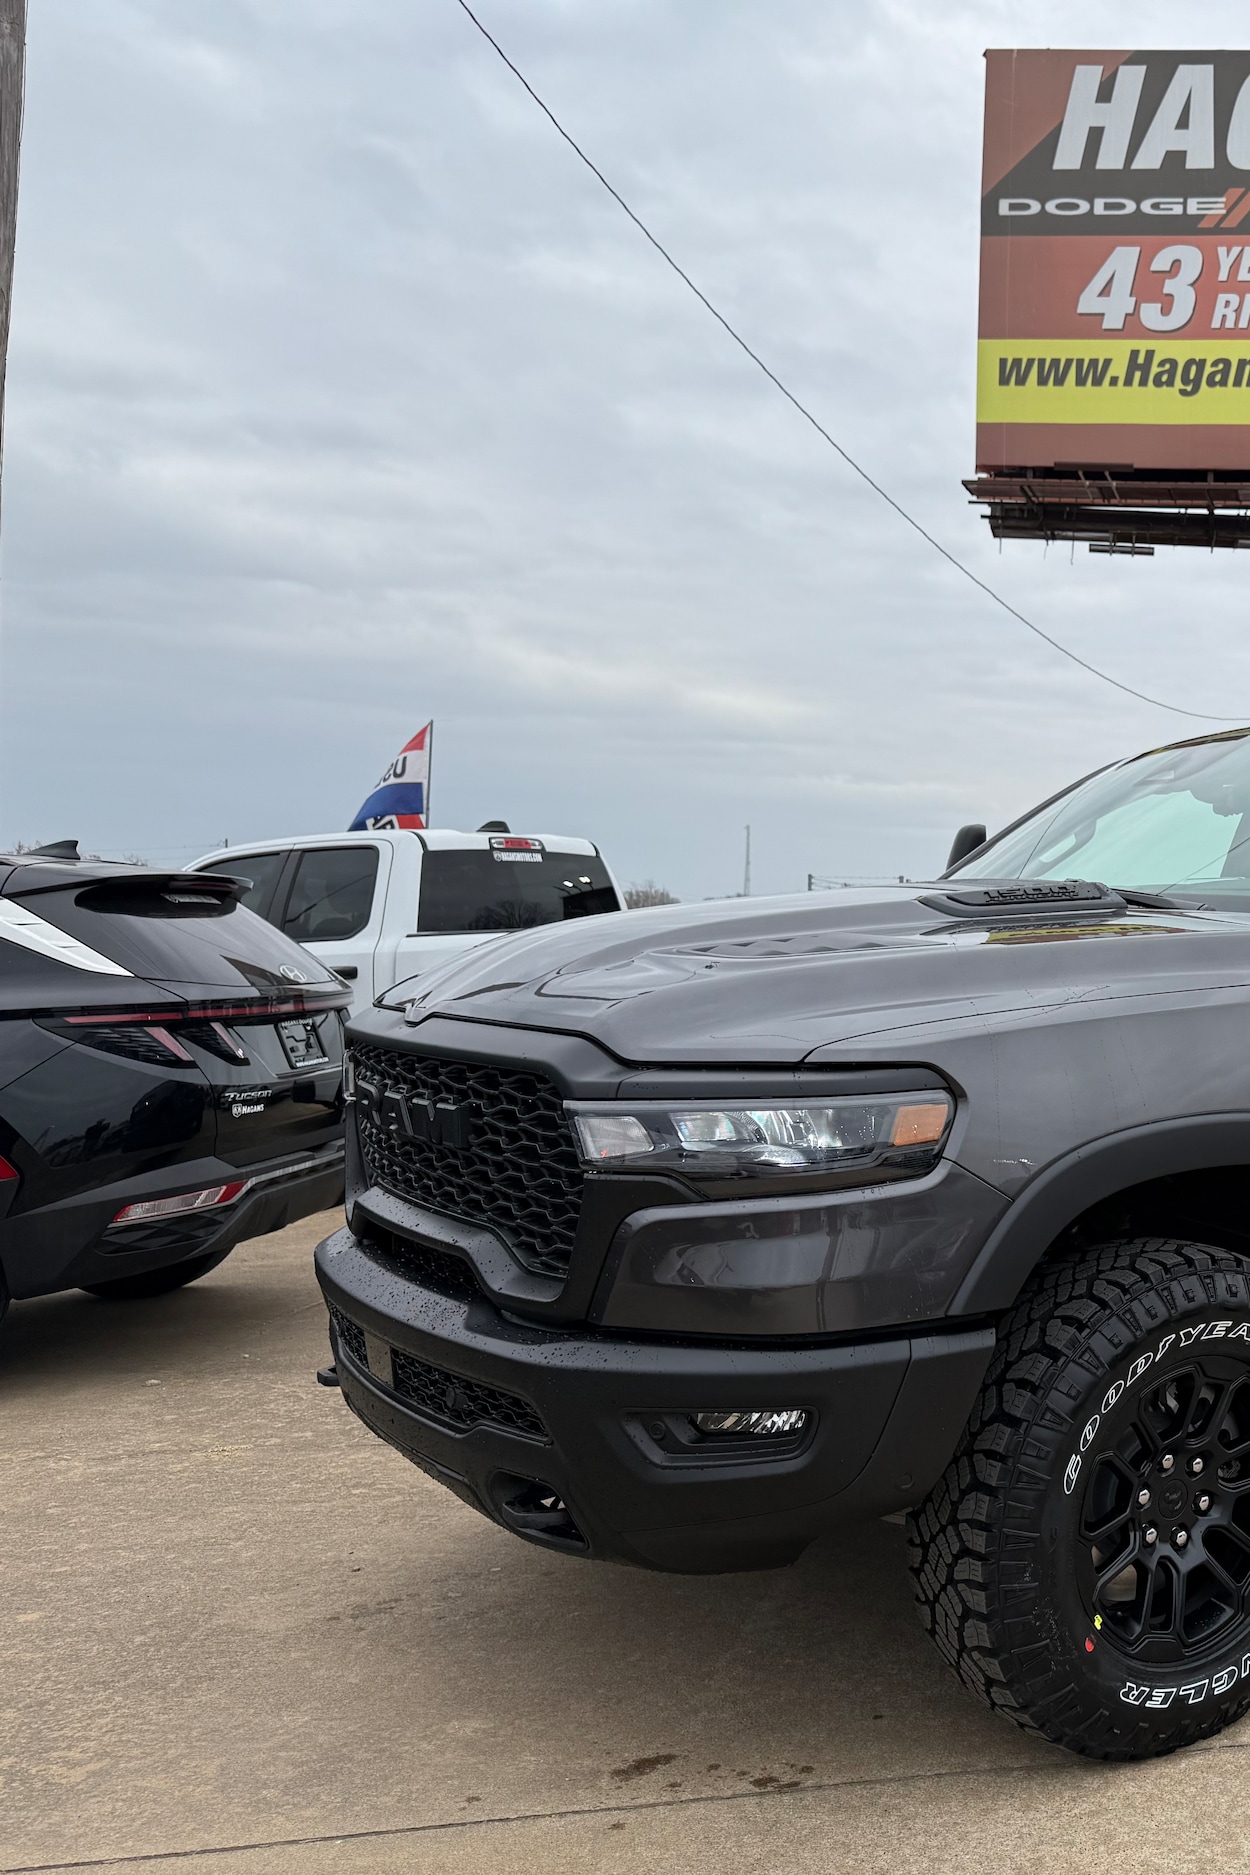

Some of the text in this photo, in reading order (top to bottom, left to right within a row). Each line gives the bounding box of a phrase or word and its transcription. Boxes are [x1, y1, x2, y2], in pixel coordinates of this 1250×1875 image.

[997, 197, 1227, 216] DODGE
[1076, 244, 1204, 333] 43
[356, 1080, 471, 1149] RAM
